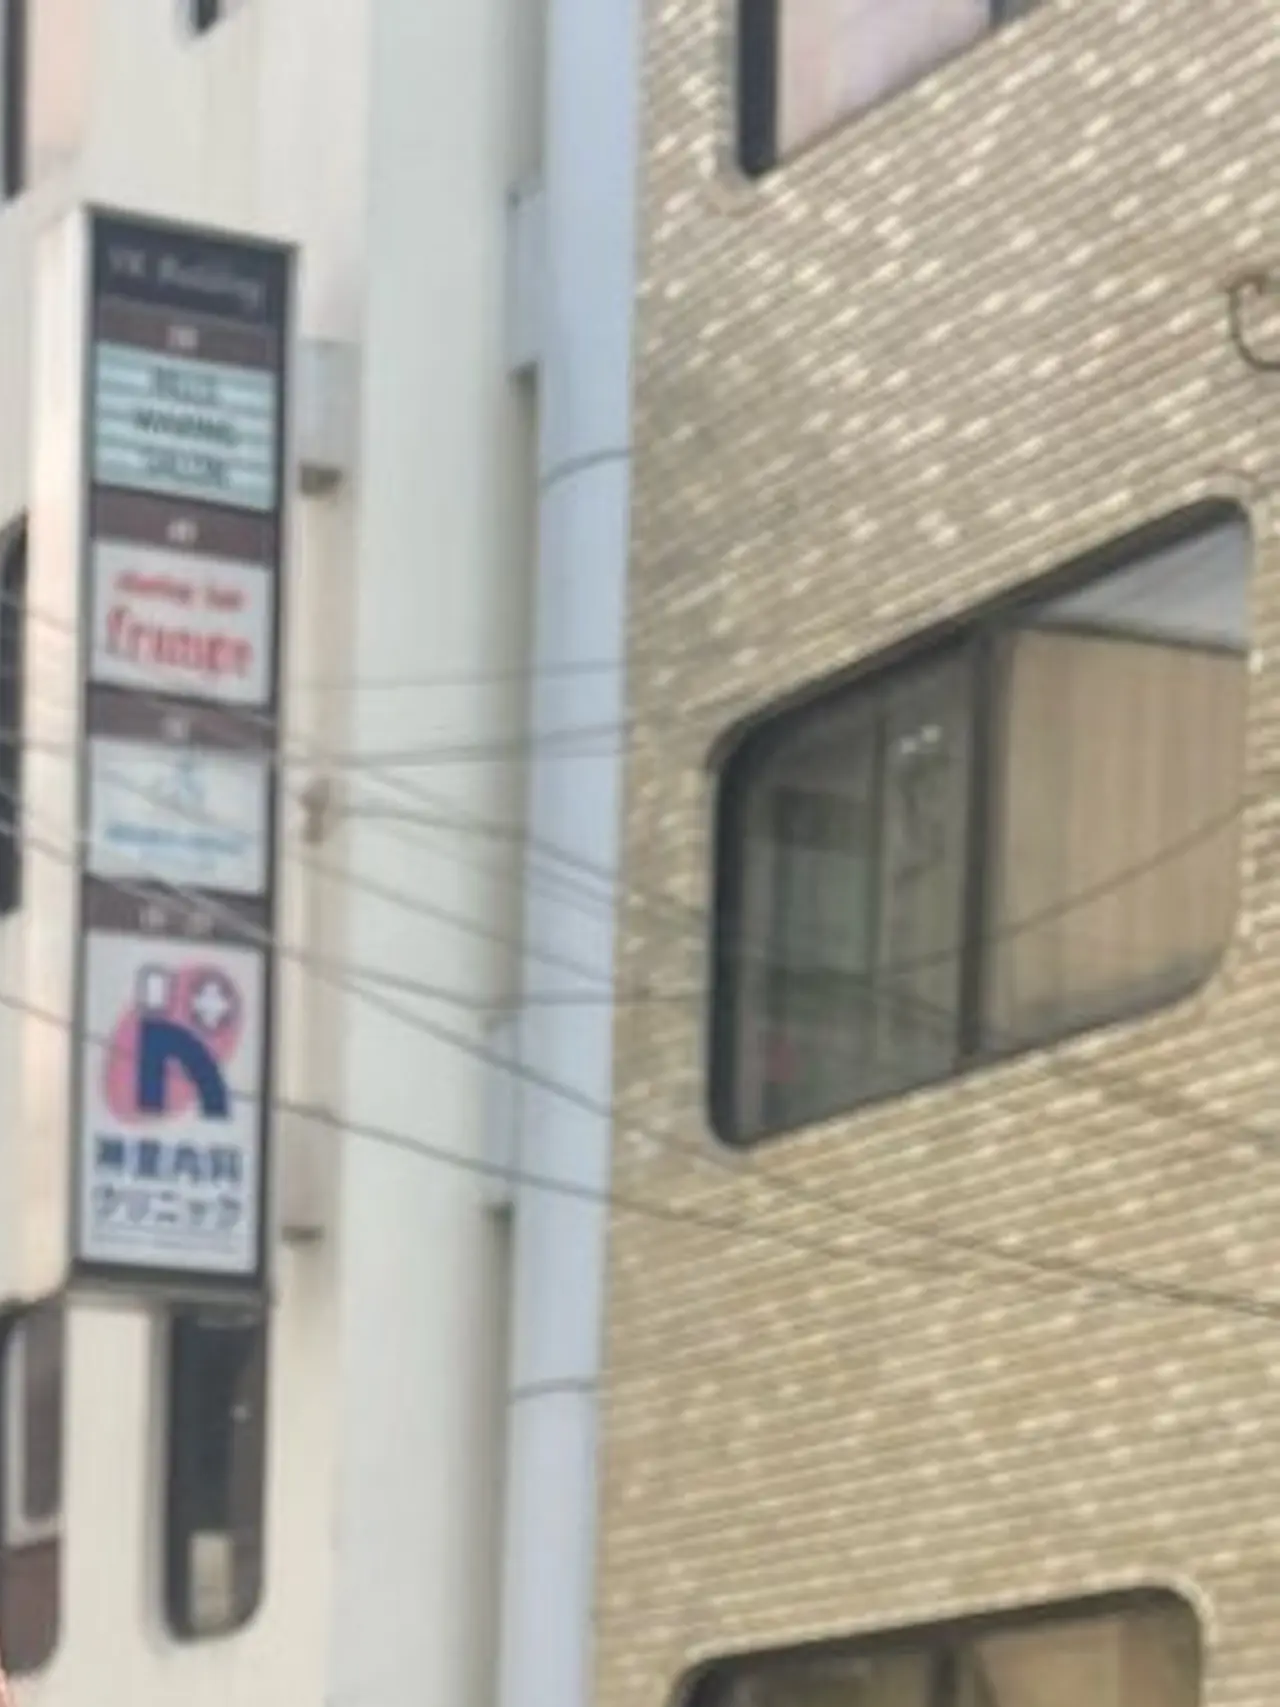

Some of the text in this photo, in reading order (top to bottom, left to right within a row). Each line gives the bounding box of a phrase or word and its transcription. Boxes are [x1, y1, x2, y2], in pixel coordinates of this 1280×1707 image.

[92, 1182, 242, 1232] クリニック
